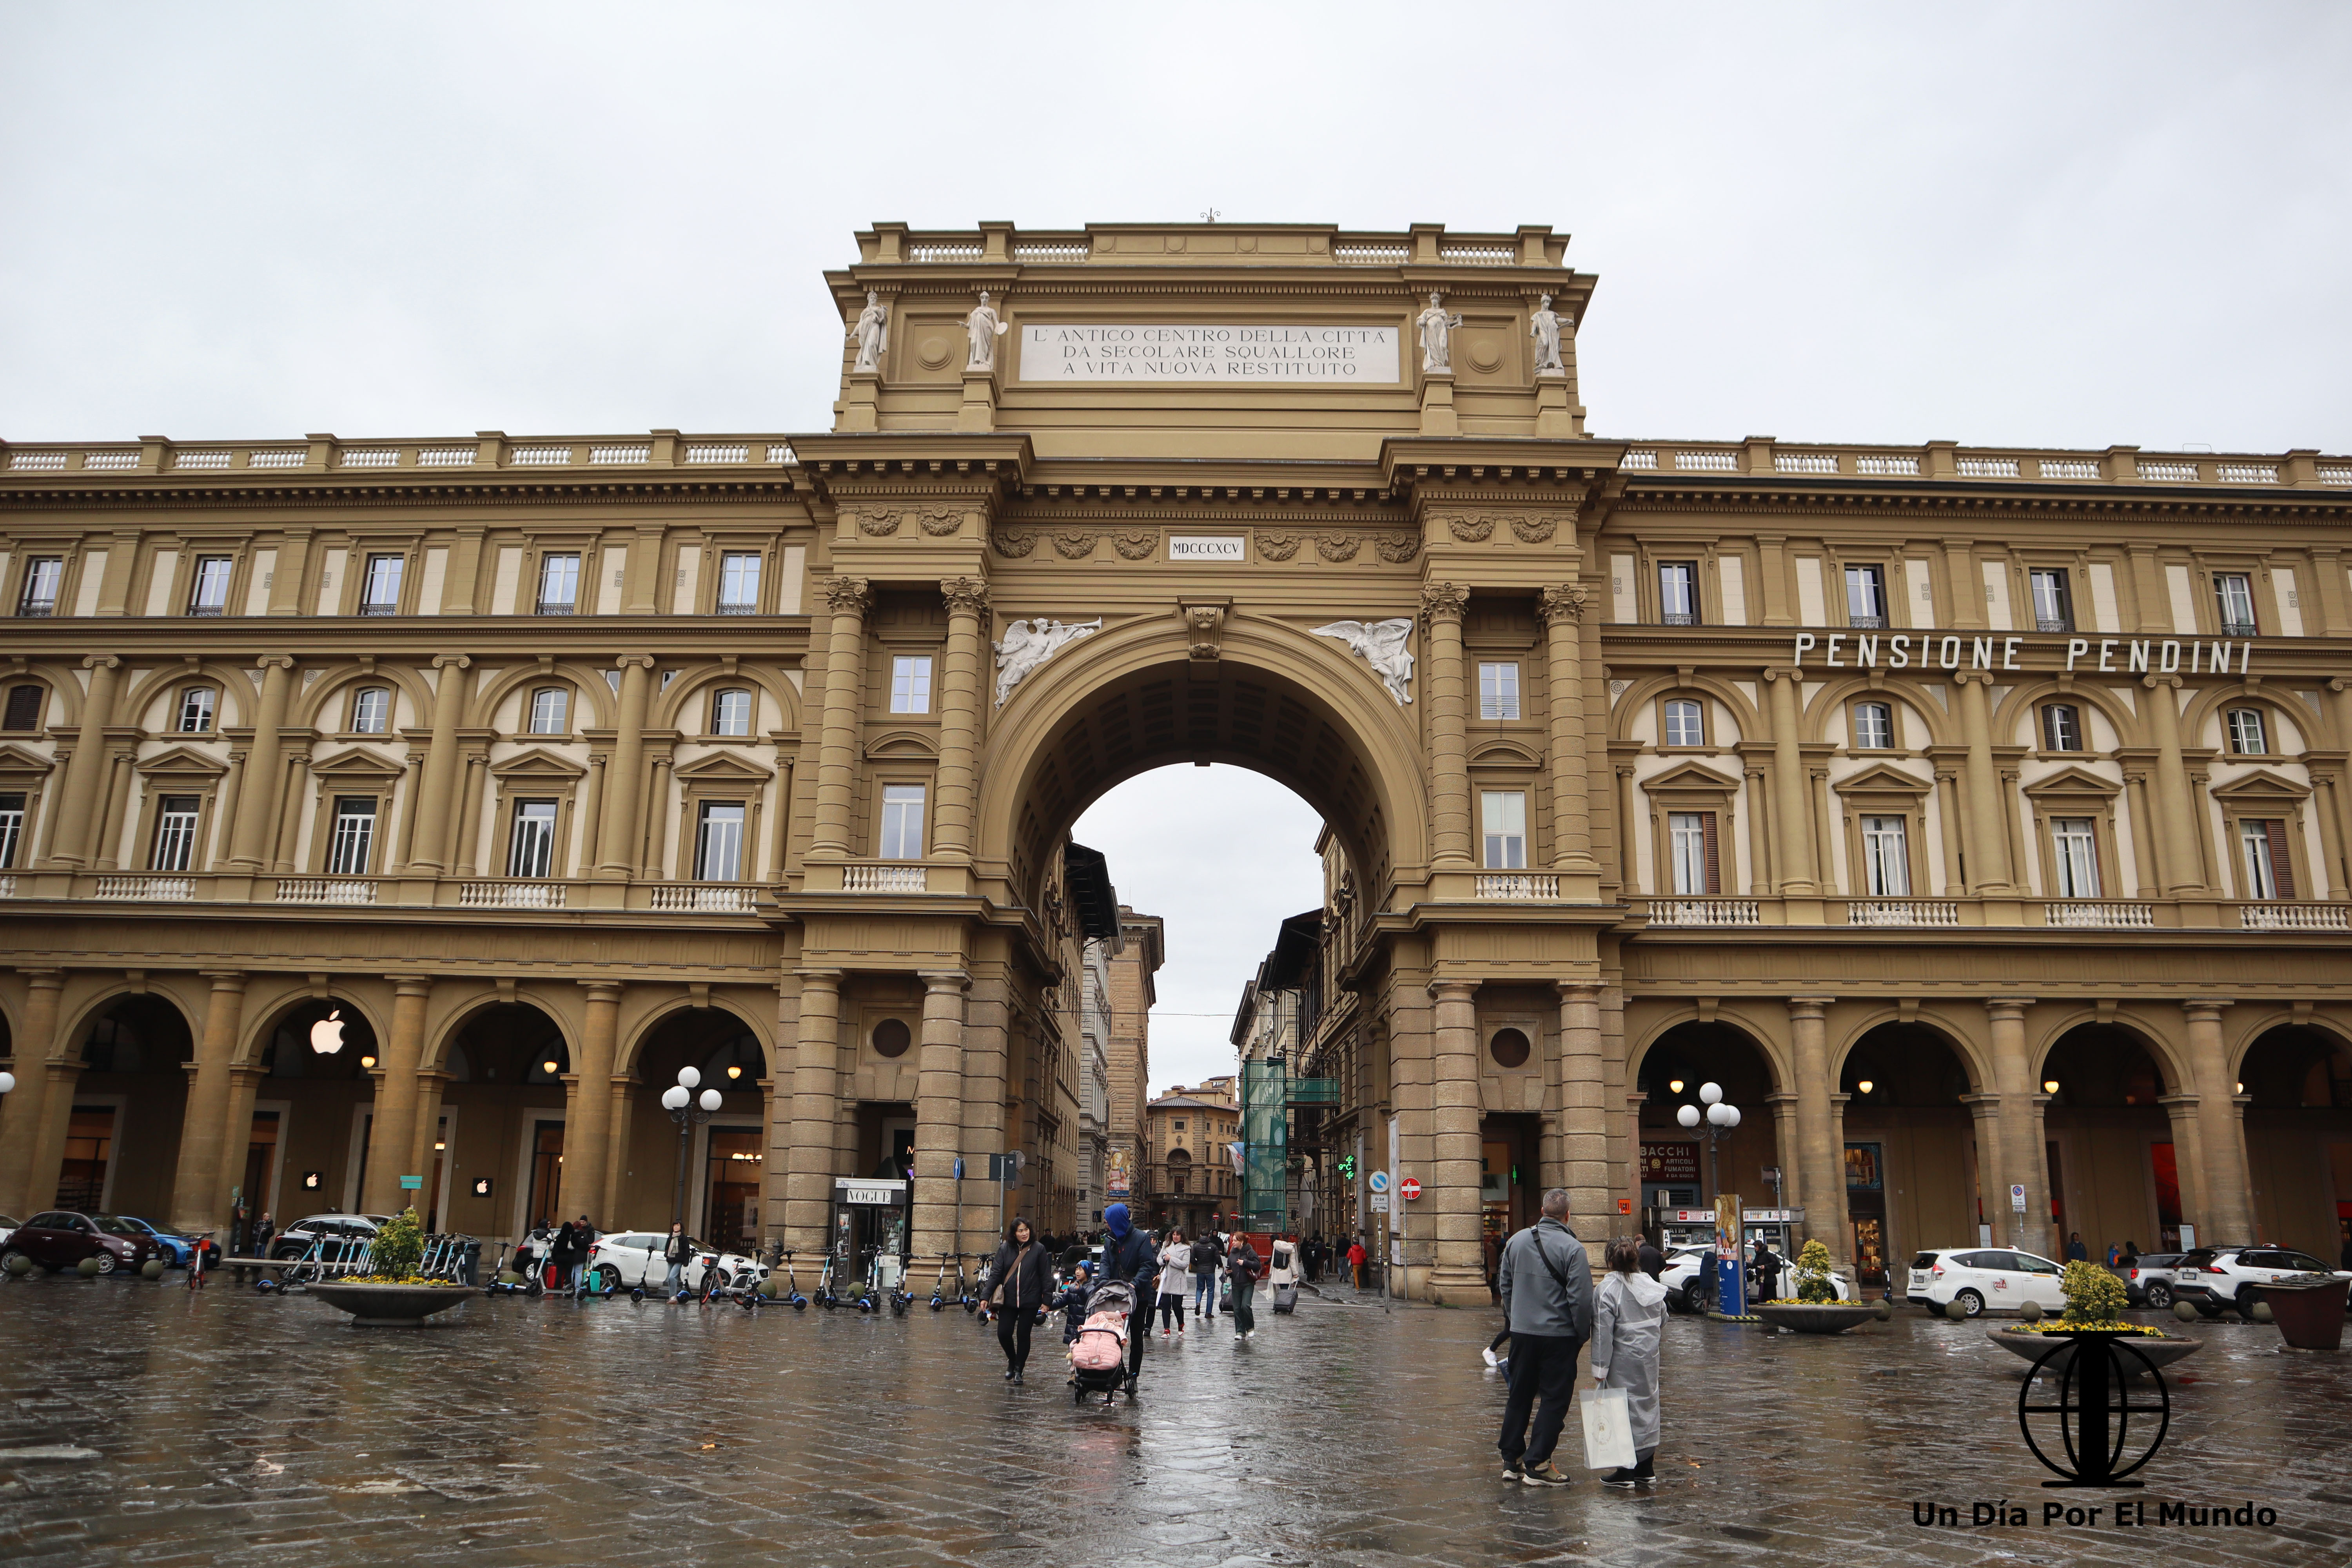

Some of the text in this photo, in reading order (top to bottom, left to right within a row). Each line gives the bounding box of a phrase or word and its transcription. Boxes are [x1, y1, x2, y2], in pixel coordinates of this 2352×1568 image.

[1058, 329, 1134, 342] ANTICO
[1143, 329, 1230, 342] CENTRO
[1240, 330, 1312, 342] DELLA
[1063, 345, 1356, 359] DA SECOLARE SQUALLORE
[1063, 362, 1356, 375] A VITA NUOVA RESTITUITO
[1172, 543, 1240, 554] MDCCCXCV
[1794, 633, 2251, 674] PENSIONE PENDINI
[849, 1191, 890, 1202] VOGUE
